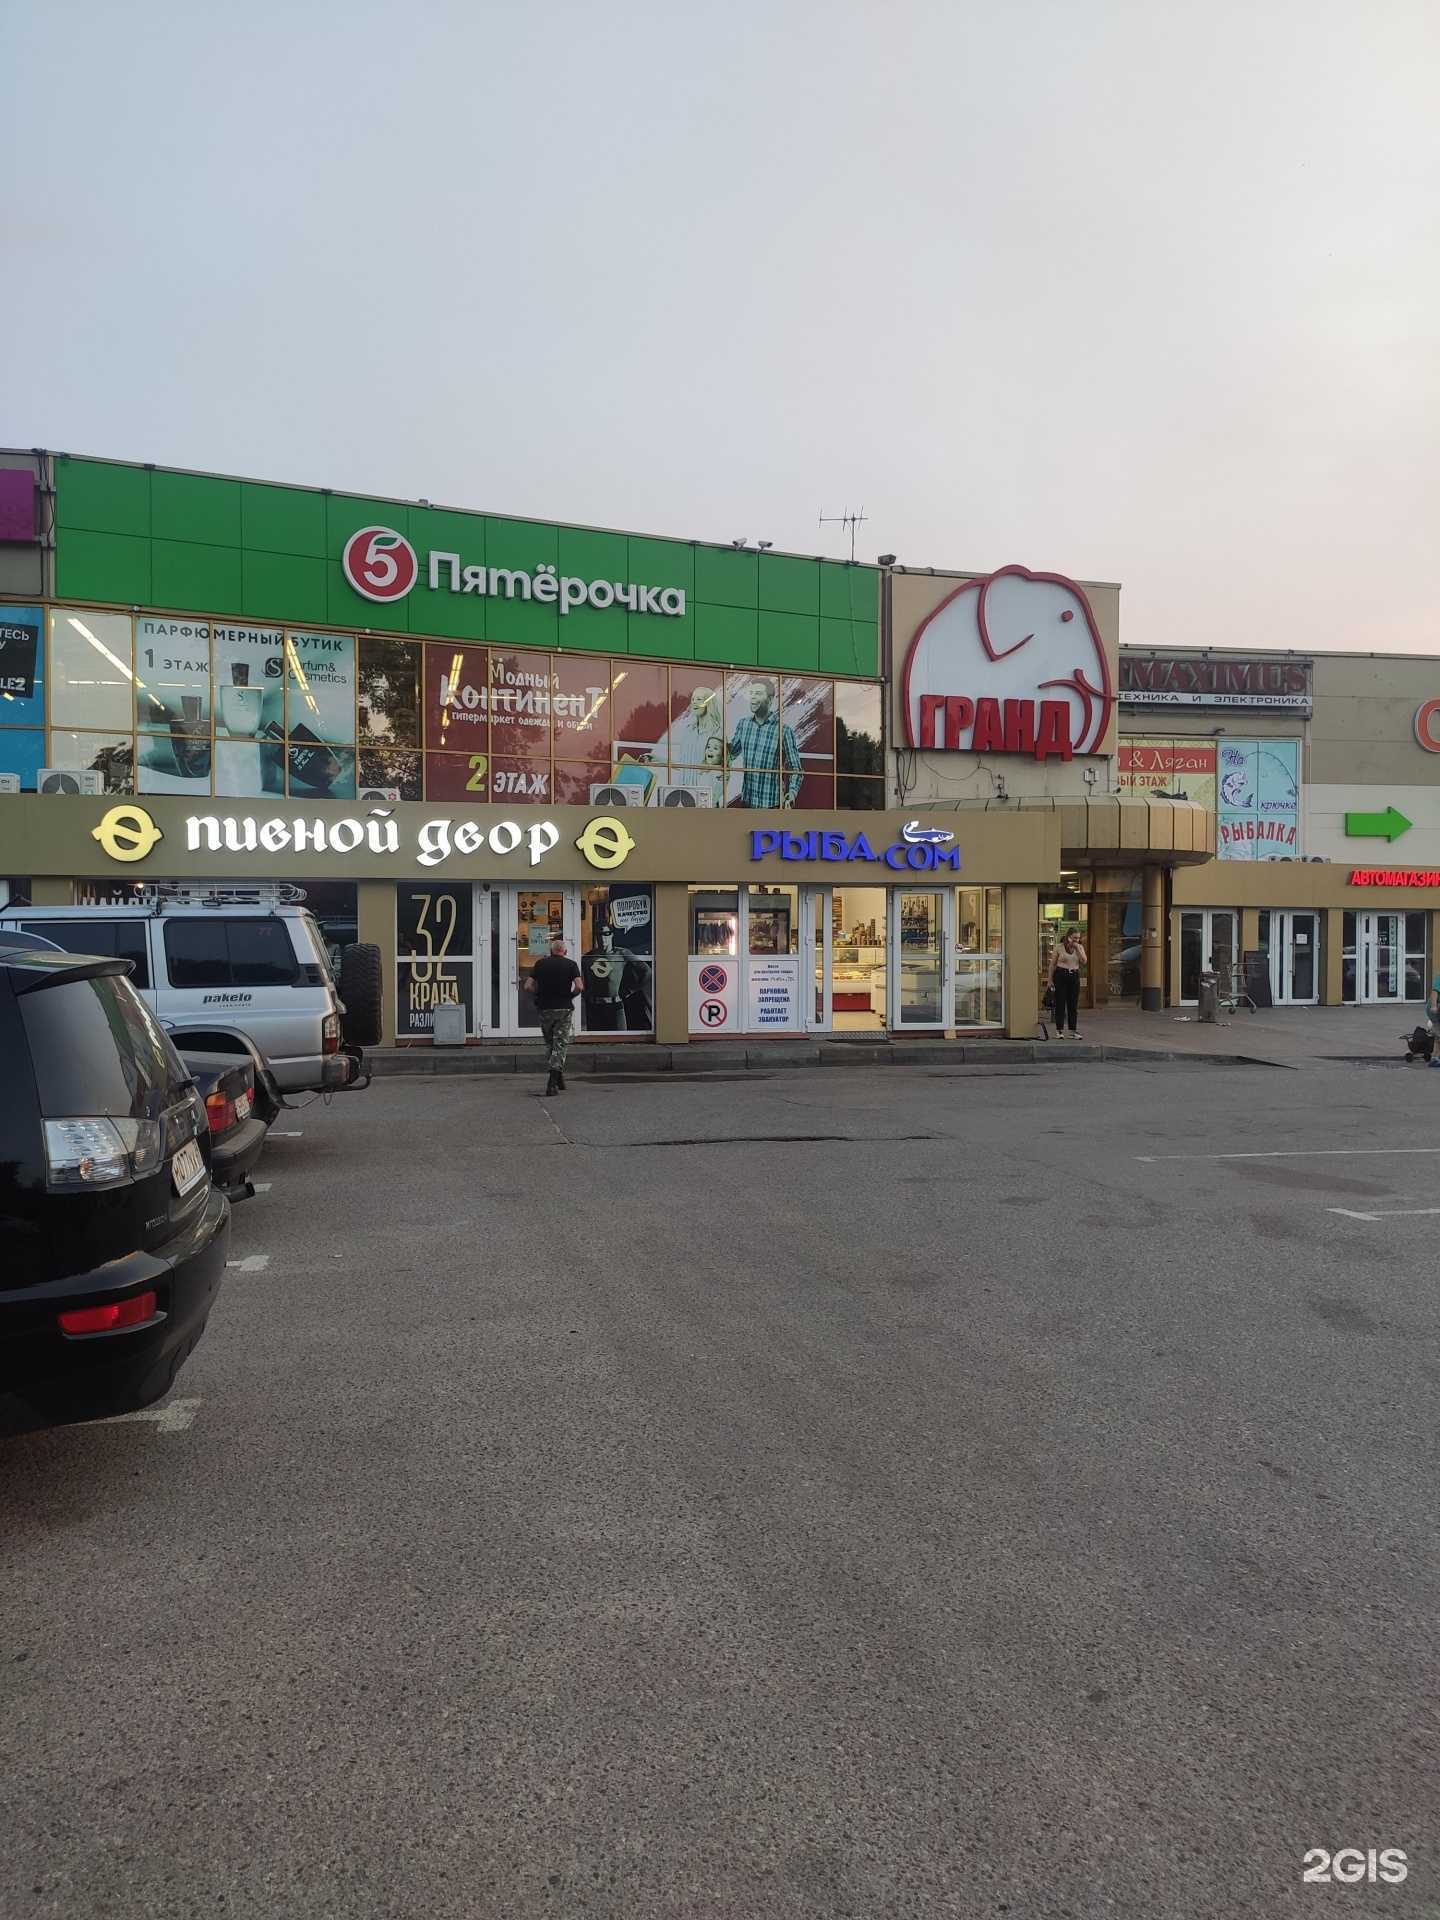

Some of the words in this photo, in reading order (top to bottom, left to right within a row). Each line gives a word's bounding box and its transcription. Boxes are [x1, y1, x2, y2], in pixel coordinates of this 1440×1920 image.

[364, 532, 401, 588] 5
[428, 550, 686, 616] Пятёрочка
[144, 622, 284, 646] ПАРФЮМЕРНЫЙ
[144, 648, 154, 668] 1
[163, 658, 208, 673] ЭТАЖ
[288, 670, 348, 684] Csmetics
[1214, 696, 1310, 705] ЭЛЕКТРОНИКА
[452, 711, 514, 726] гипермркет
[567, 719, 593, 731] оби
[919, 694, 1073, 762] ГРАНД
[466, 755, 488, 791] 2
[493, 771, 549, 794] ЭТАЖ
[1140, 775, 1168, 786] ЭТАЖ
[184, 807, 400, 854] пивной
[416, 816, 560, 867] двор
[1220, 820, 1297, 846] РЫБАЛКА
[411, 894, 458, 983] 32
[202, 992, 252, 1004] pakelo
[410, 982, 459, 1010] КРАНА
